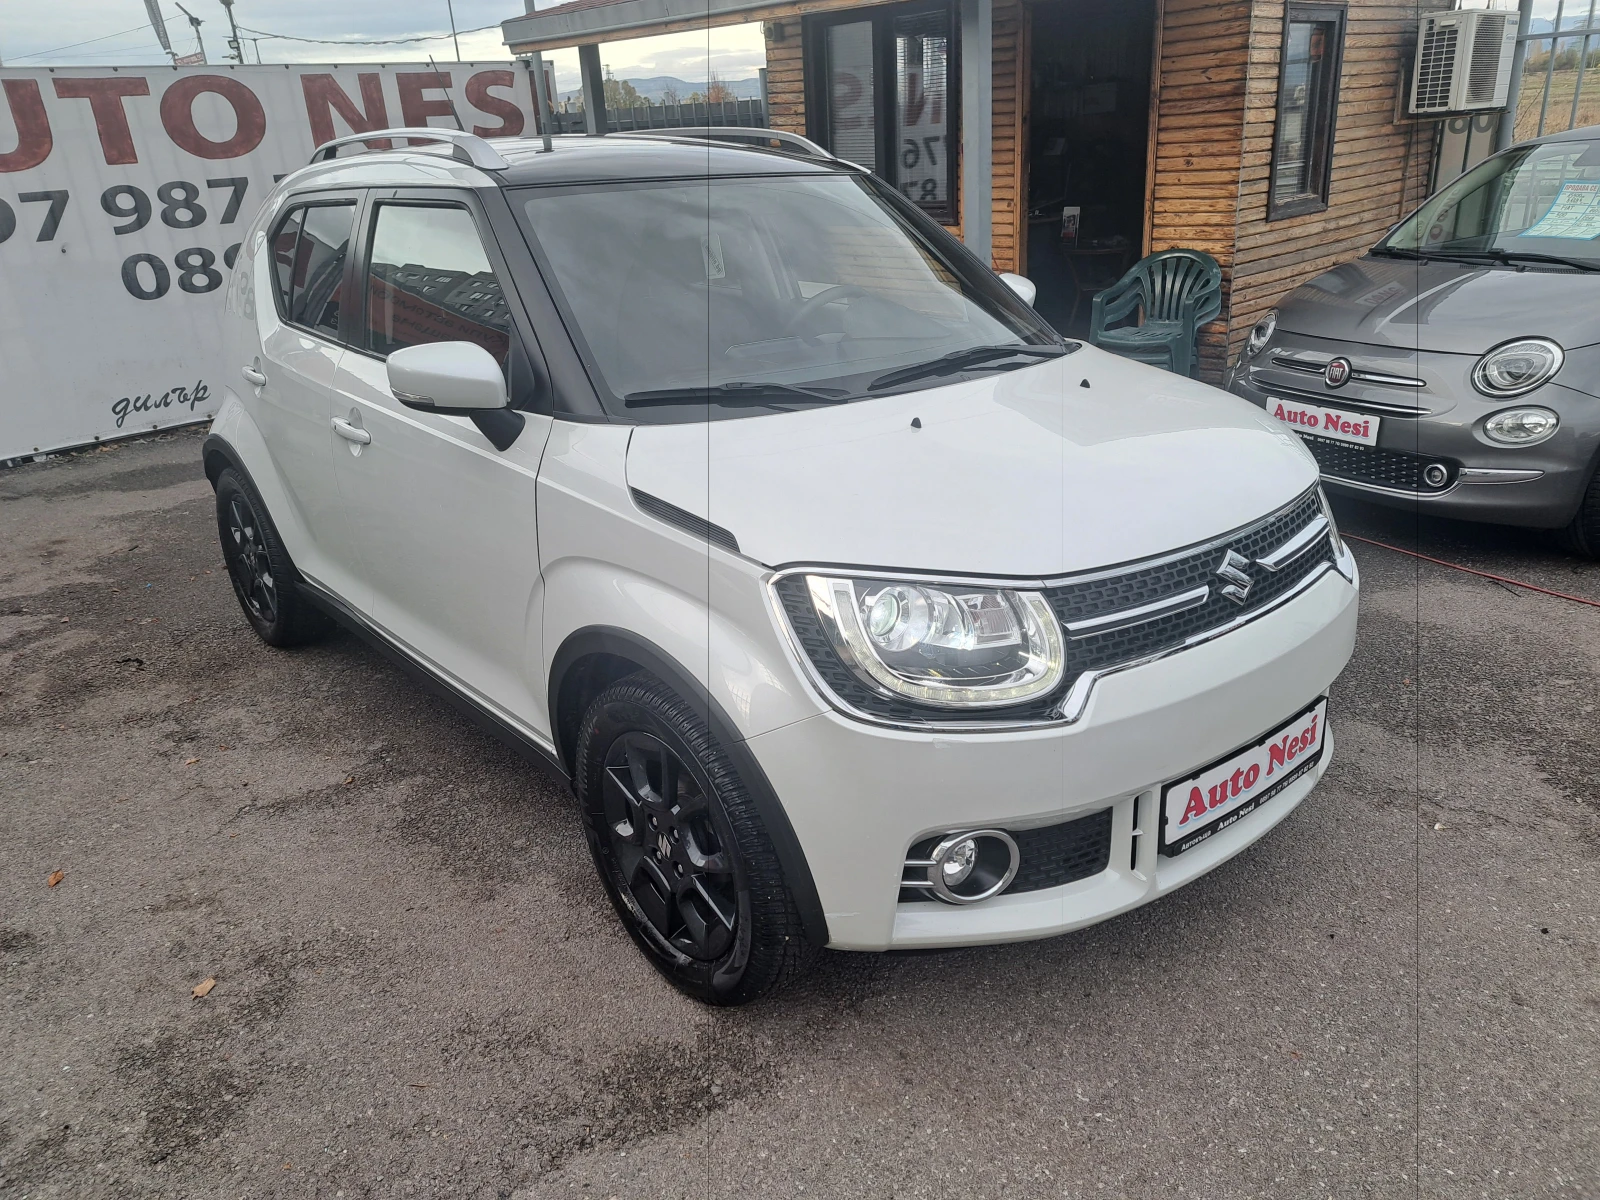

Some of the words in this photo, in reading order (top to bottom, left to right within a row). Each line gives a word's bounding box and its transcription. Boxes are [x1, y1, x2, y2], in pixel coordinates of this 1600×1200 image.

[1330, 366, 1343, 379] FIAT
[1274, 403, 1318, 427] Auto
[1324, 413, 1370, 438] Nesi
[1178, 763, 1260, 826] Auto
[1266, 714, 1318, 777] Nesi
[1217, 815, 1237, 831] Auto
[1239, 802, 1254, 818] Nesi
